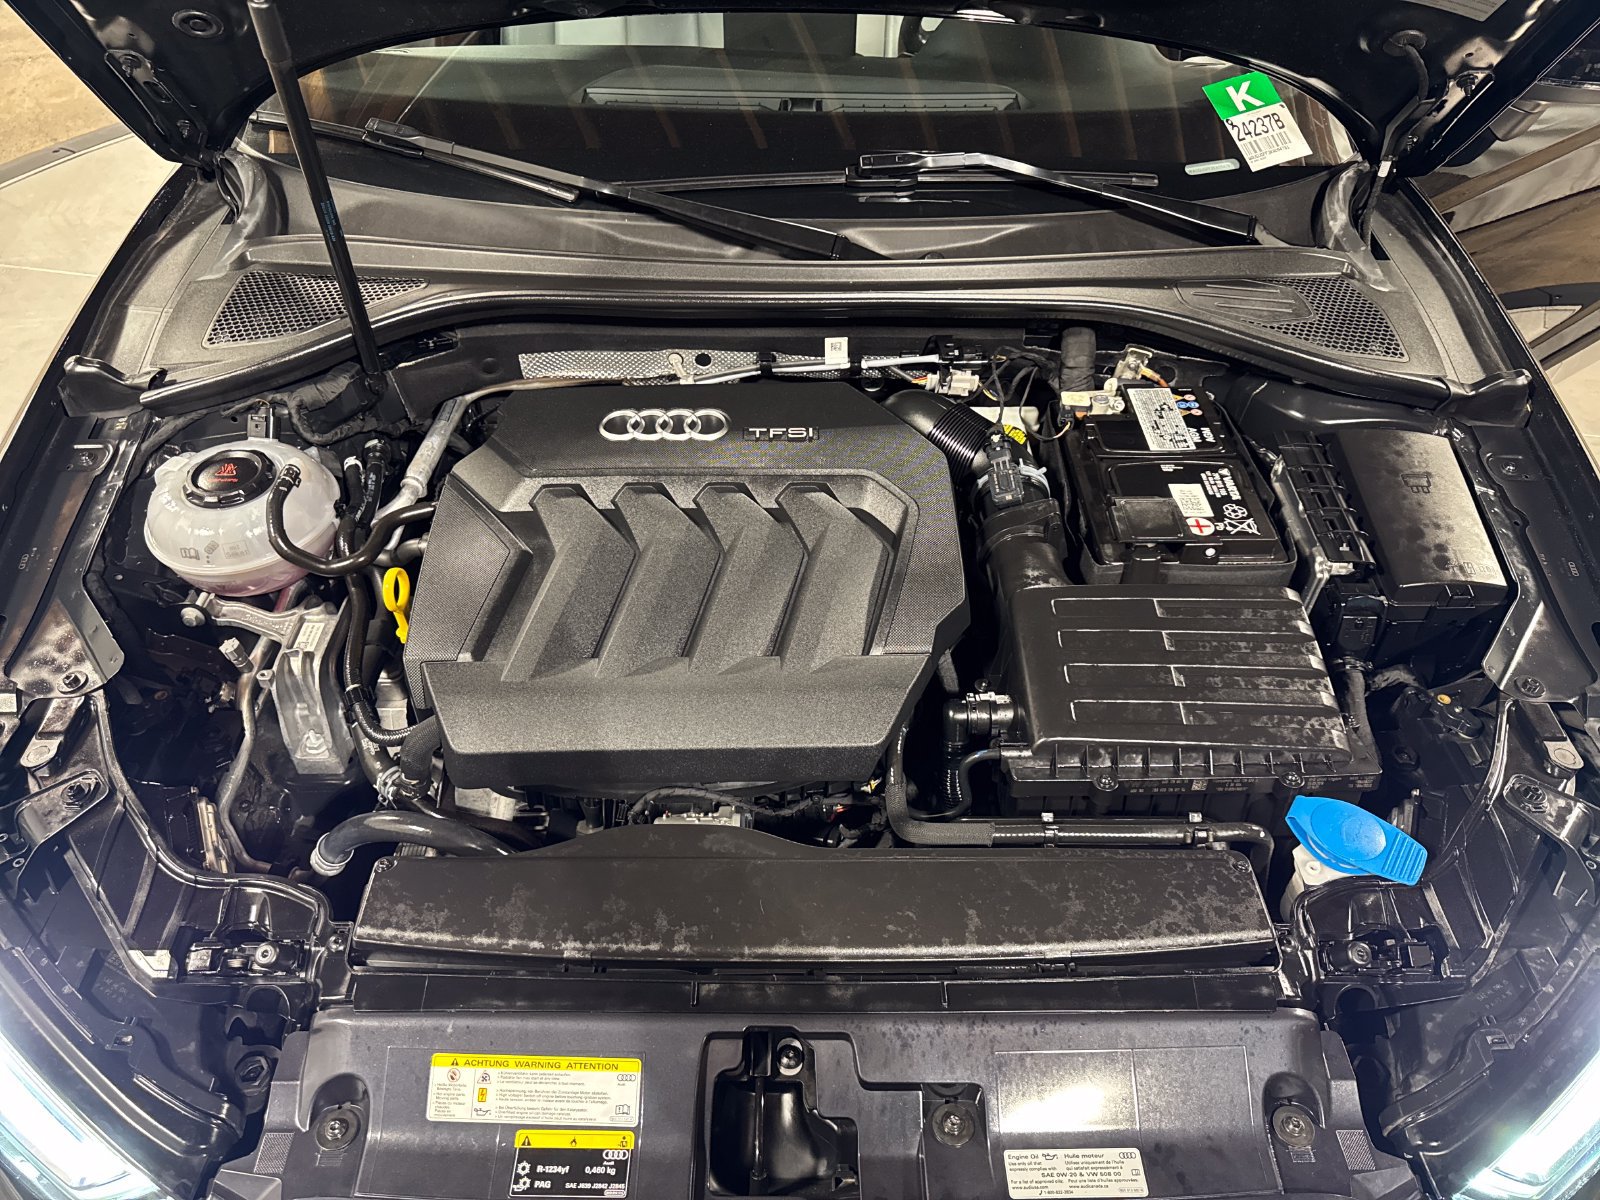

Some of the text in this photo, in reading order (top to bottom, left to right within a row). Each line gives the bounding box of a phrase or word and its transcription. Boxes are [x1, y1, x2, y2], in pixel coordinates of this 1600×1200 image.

[1225, 81, 1265, 111] K
[1234, 112, 1285, 141] 24237B
[748, 427, 813, 438] TFSI
[464, 1059, 619, 1070] ACHTUNG WARNING ATTENTION
[537, 1165, 570, 1174] R-1234yf
[607, 1167, 616, 1175] kg
